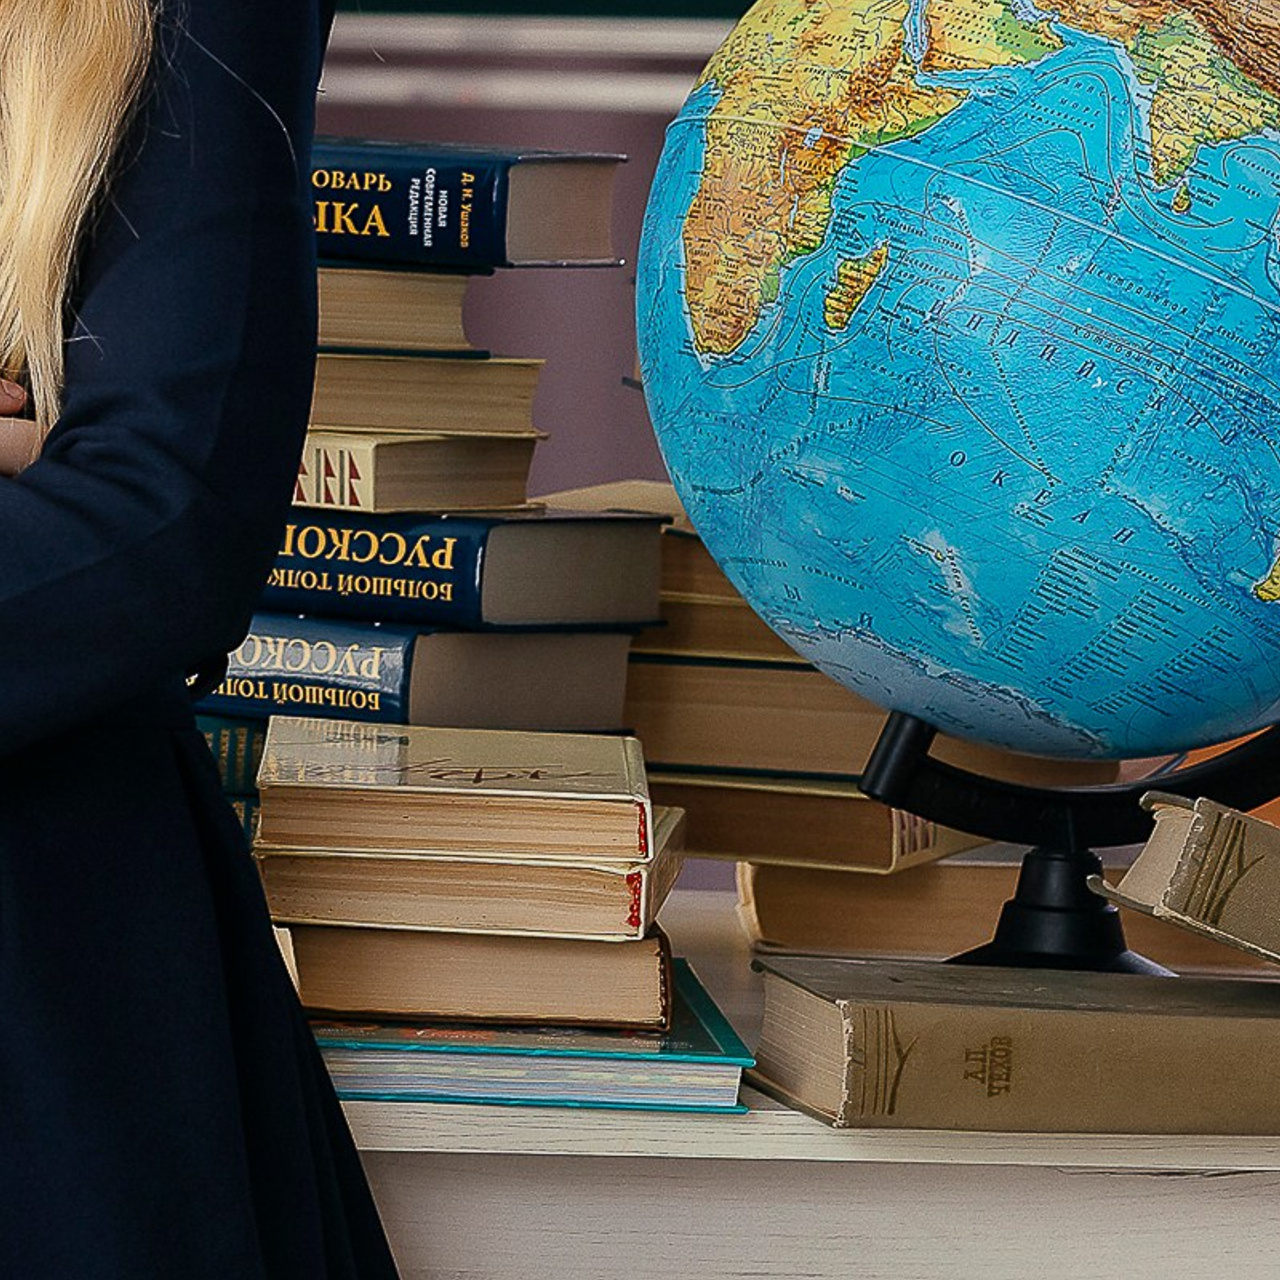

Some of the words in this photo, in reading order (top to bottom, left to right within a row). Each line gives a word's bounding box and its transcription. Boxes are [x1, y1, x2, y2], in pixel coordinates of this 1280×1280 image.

[407, 177, 421, 236] РЕДАКЦИЯ
[423, 167, 436, 248] СОВРЕМЕННАЯ
[437, 189, 448, 228] НОВАЯ
[459, 204, 473, 249] Ушаков
[1086, 262, 1190, 317] Центральная
[949, 450, 1136, 546] ОКЕАН
[337, 573, 454, 602] БОЛЬШОЙ
[272, 682, 381, 711] БОЛЬШОЙ
[987, 1036, 1014, 1098] ЧЕХОВ
